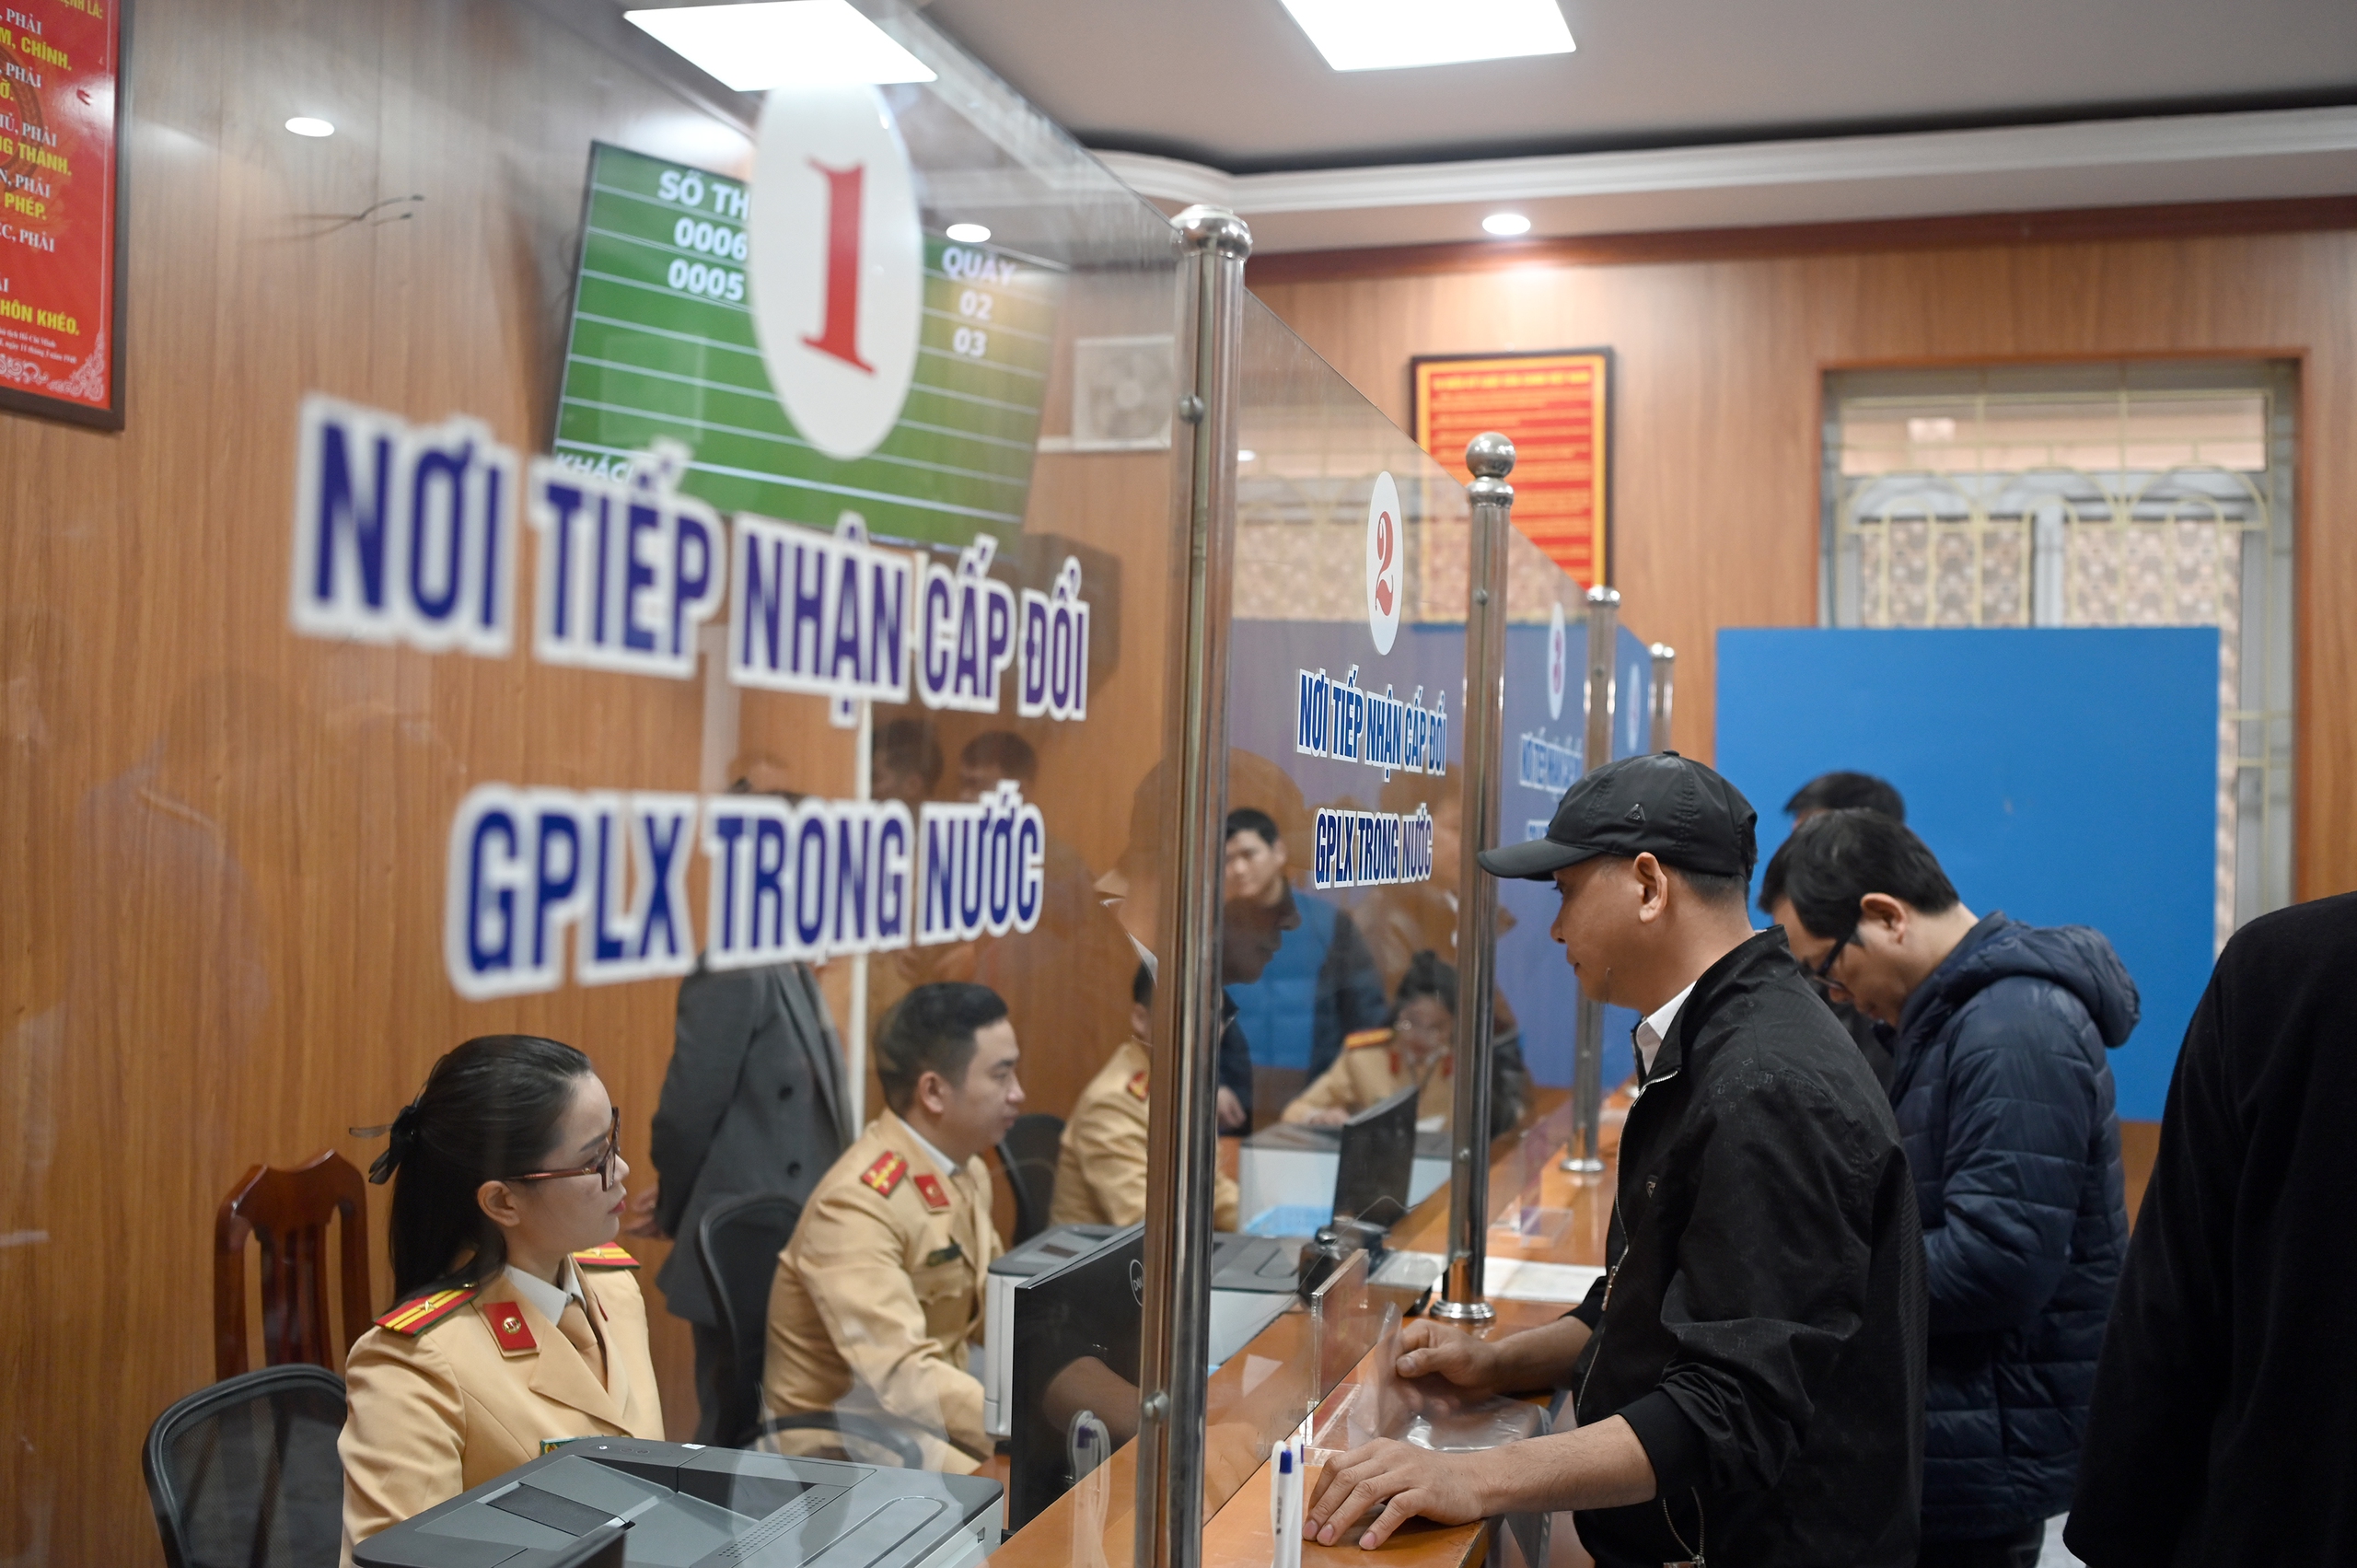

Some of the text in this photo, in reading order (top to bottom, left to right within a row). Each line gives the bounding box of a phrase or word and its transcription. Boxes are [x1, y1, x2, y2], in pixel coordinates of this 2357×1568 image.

[6, 7, 42, 35] PHẢI
[21, 36, 73, 72] CHÍNH.
[6, 62, 42, 88] PHẢI
[22, 122, 58, 147] PHẢI
[17, 142, 73, 177] THÀNH.
[15, 173, 52, 199] PHẢI
[711, 181, 749, 221] TH
[4, 192, 47, 221] PHÉP.
[19, 228, 55, 253] PHẢI
[673, 216, 749, 261] 0006
[667, 258, 745, 302] 0005
[799, 154, 877, 376] 1
[0, 297, 80, 337] HÔN KHÉO.
[959, 289, 993, 321] 02
[952, 326, 988, 358] 03
[556, 452, 633, 484] KHÁC
[306, 412, 1086, 718] NƠI TIẾP NHẬN CẤP ĐỔI
[1375, 510, 1395, 617] 2
[1297, 669, 1330, 754] NƠI
[1331, 667, 1364, 761] TIẾP
[1364, 681, 1402, 781] NHẬN
[1404, 688, 1427, 769] CẤP
[1428, 693, 1446, 773] ĐỔI
[1314, 805, 1433, 886] GPLX TRONG NƯỚC
[463, 789, 1041, 981] GPLX TRONG NƯỚC
